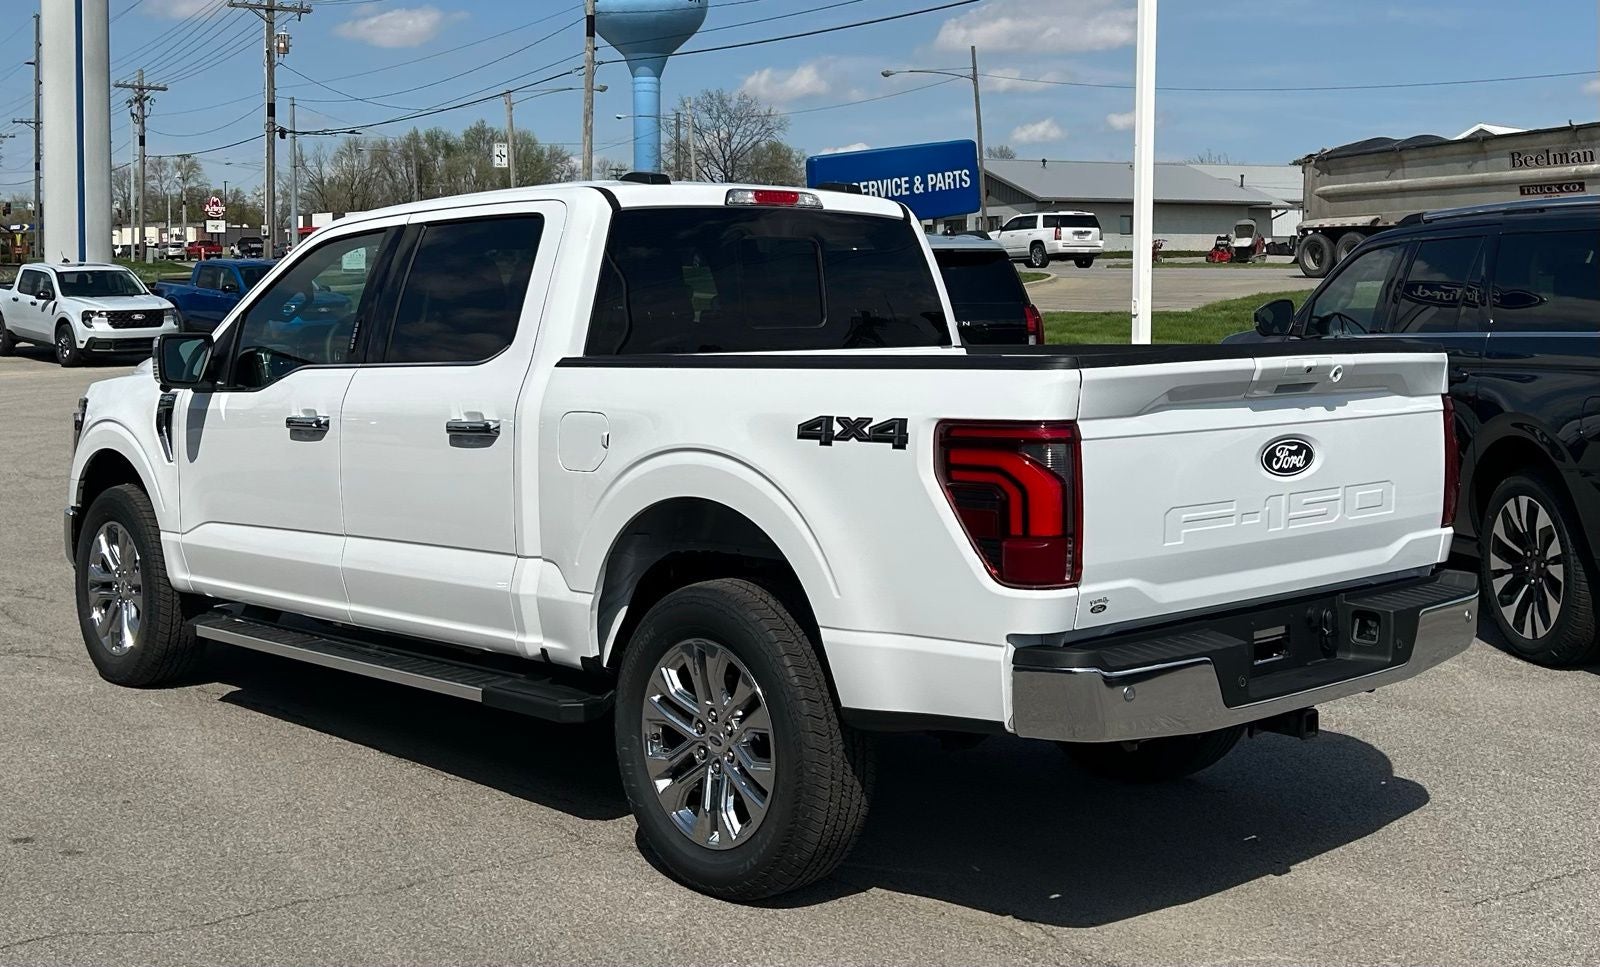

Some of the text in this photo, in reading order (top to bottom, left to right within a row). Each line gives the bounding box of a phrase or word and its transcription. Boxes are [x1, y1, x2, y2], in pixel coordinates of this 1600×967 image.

[1510, 149, 1595, 168] Beelman
[913, 175, 924, 194] &
[928, 169, 971, 192] PARTS
[1522, 183, 1582, 195] TRUCK CO.
[1272, 444, 1306, 469] Ford
[1163, 479, 1396, 546] F-150
